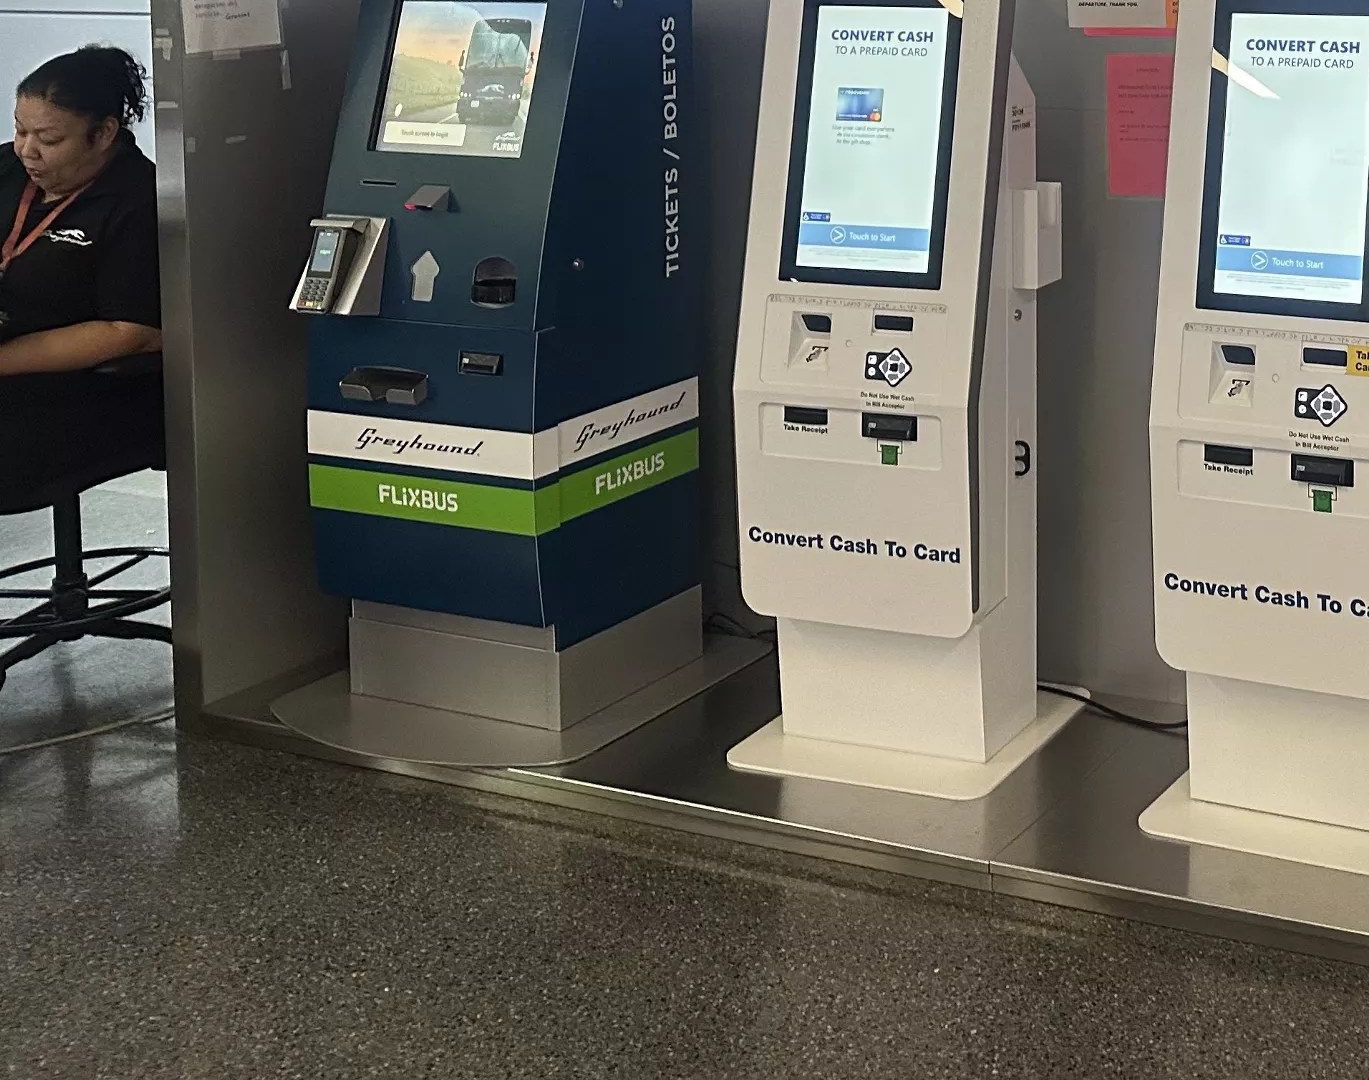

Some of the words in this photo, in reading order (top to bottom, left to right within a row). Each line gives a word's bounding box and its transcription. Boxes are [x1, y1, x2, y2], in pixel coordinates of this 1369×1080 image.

[831, 29, 895, 42] CONVERT
[897, 30, 934, 43] CASH
[835, 46, 847, 55] TO
[850, 46, 857, 55] A
[860, 46, 899, 56] PREPAID
[901, 46, 928, 57] CARD
[1246, 39, 1315, 53] CONVERT
[1319, 40, 1360, 54] CASH
[1251, 56, 1264, 66] TO
[1267, 57, 1275, 66] A
[1278, 57, 1322, 68] PREPAID
[1324, 58, 1354, 69] CARD
[661, 16, 678, 140] BOLETOS
[665, 148, 680, 160] /
[665, 167, 681, 278] TICKETS
[849, 232, 869, 242] Touch
[870, 232, 878, 242] to
[879, 232, 896, 243] Start
[1272, 256, 1295, 268] Touch
[1296, 258, 1305, 268] to
[1306, 258, 1324, 269] Start
[574, 391, 687, 453] Greyhound
[784, 424, 799, 432] Take
[802, 426, 828, 434] Receipt
[355, 427, 485, 458] Greyhound
[1335, 435, 1349, 443] Cash
[1204, 463, 1222, 472] Take
[1224, 466, 1253, 476] Receipt
[749, 526, 824, 549] Convert
[829, 535, 877, 555] Cash
[885, 540, 907, 558] To
[913, 545, 961, 564] Card
[1164, 573, 1248, 600] Convert
[1255, 586, 1308, 608] Cash
[1317, 593, 1342, 613] To
